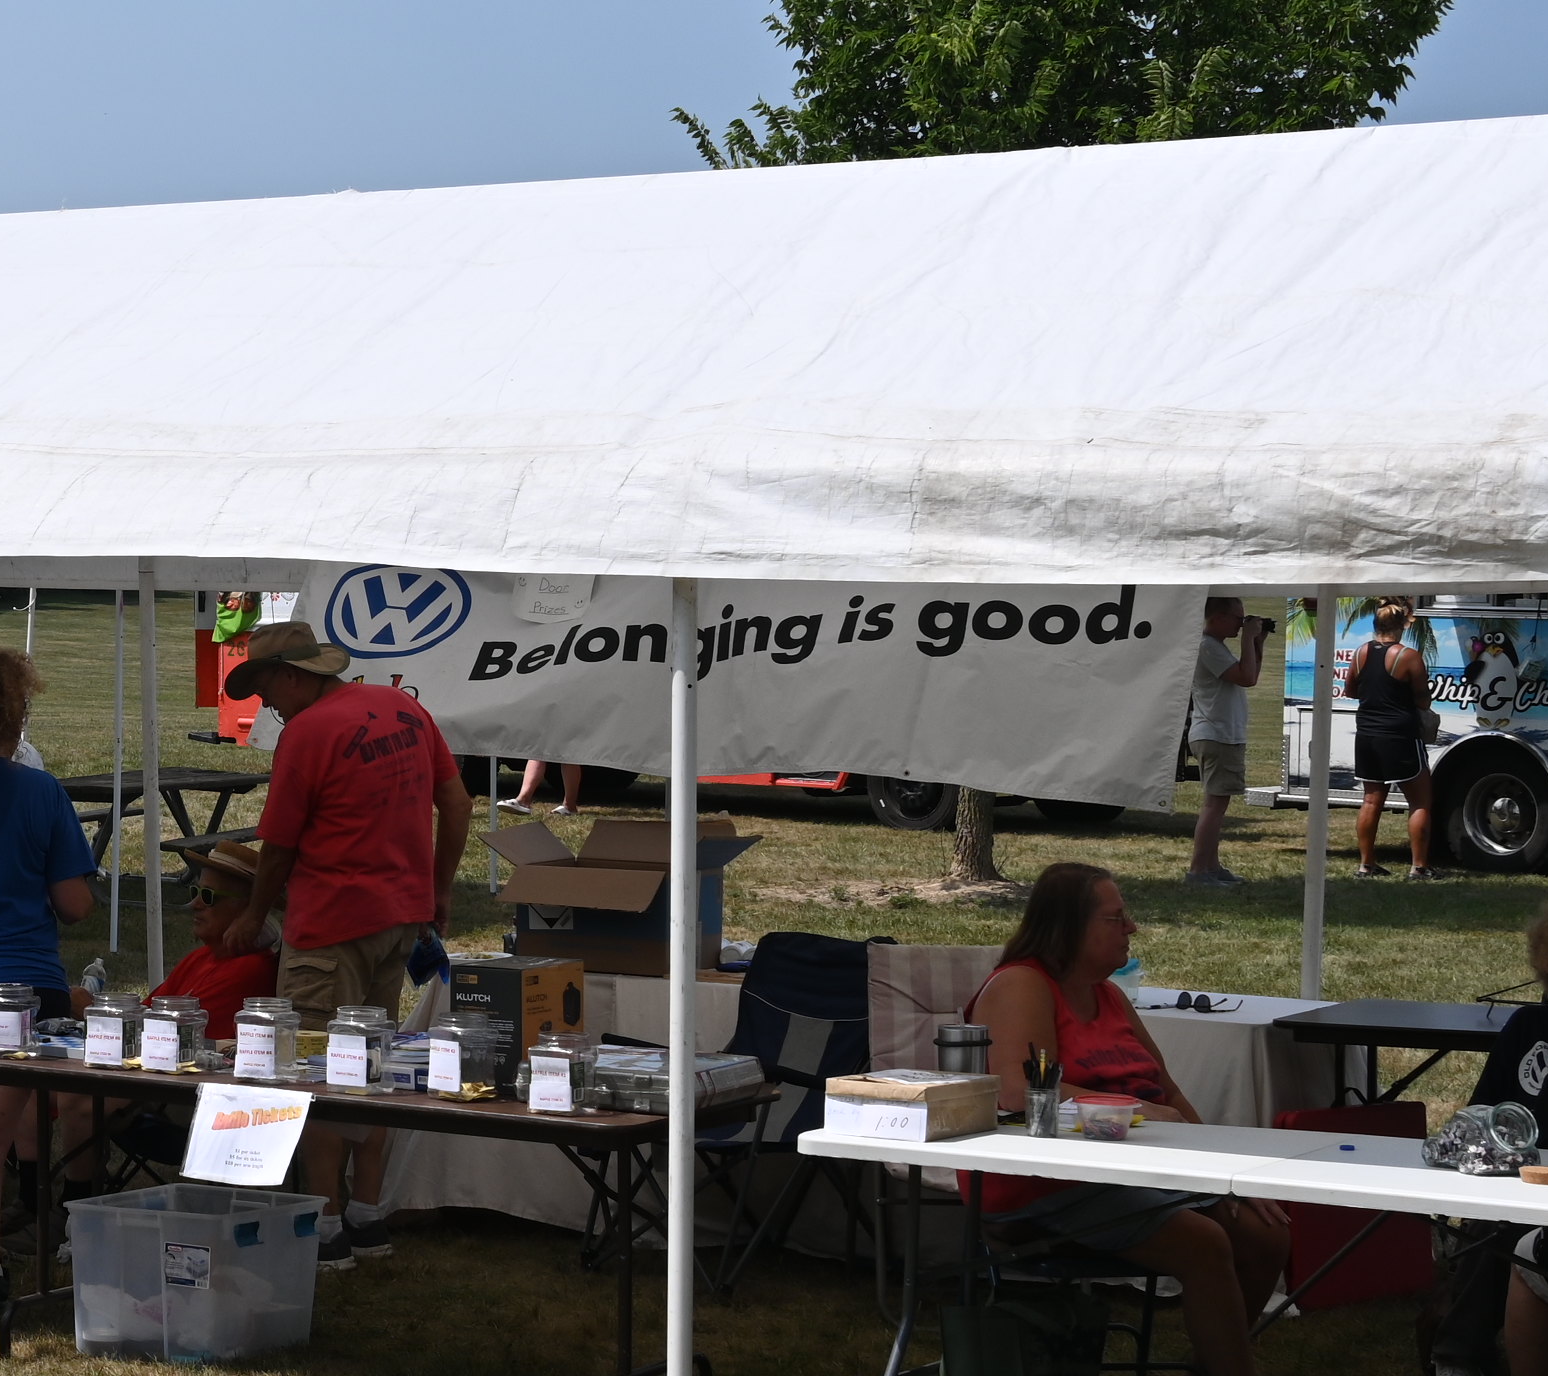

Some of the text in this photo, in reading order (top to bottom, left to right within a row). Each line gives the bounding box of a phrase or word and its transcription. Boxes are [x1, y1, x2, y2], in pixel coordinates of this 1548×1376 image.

[539, 577, 569, 593] Door
[533, 601, 566, 614] Prizes
[838, 595, 896, 643] is
[916, 584, 1152, 657] good.
[456, 992, 491, 1002] KLUTCH
